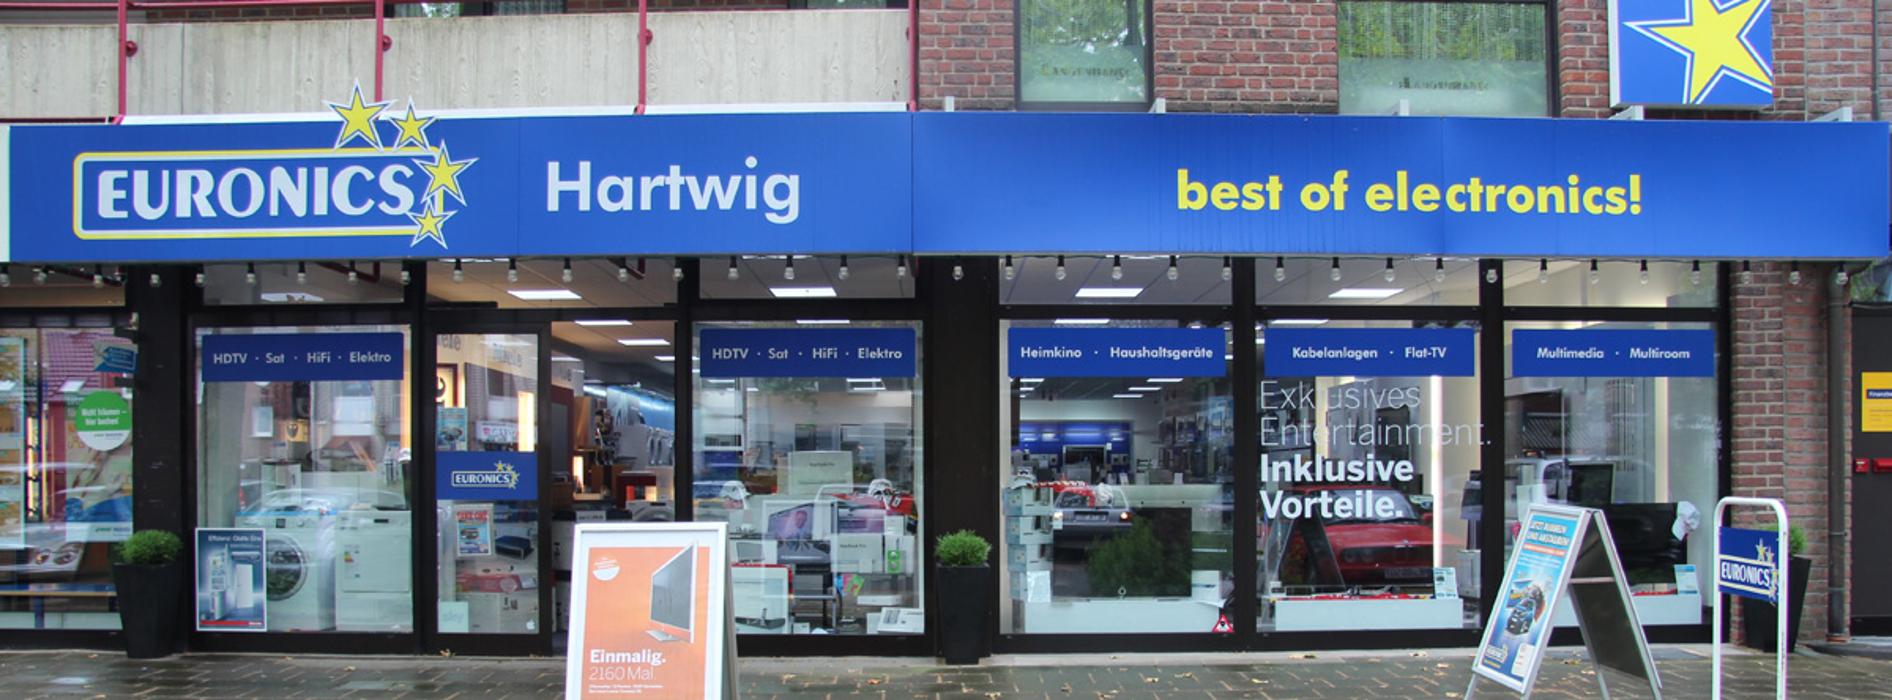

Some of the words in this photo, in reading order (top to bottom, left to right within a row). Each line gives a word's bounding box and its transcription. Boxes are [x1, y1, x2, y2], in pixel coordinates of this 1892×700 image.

[98, 164, 415, 220] EURONICS
[547, 157, 800, 224] Hartwig
[1177, 168, 1283, 211] best
[1300, 169, 1349, 211] of
[1365, 170, 1642, 215] electronics!
[213, 352, 248, 365] HDTV
[265, 351, 285, 364] Sat
[306, 350, 331, 363] HiFi
[349, 350, 392, 363] Elektro
[712, 348, 749, 360] HDTV
[768, 347, 789, 359] Sat
[812, 347, 838, 359] HiFi
[857, 347, 903, 359] Elektro
[1020, 346, 1082, 359] Heimkino
[1109, 346, 1214, 361] Haushaltsgeräte
[1292, 346, 1379, 361] Kabelanlagen
[1405, 346, 1447, 359] Flat-TV
[1537, 347, 1605, 359] Multimedia
[1629, 347, 1690, 359] Multiroom
[1260, 417, 1492, 446] Entertainment.
[1261, 453, 1414, 482] Inklusive
[455, 473, 510, 484] EURONICS
[1260, 490, 1403, 519] Vorteile.
[1721, 562, 1771, 587] EURONICS
[590, 648, 667, 666] Einmalig.
[589, 666, 625, 681] 2160
